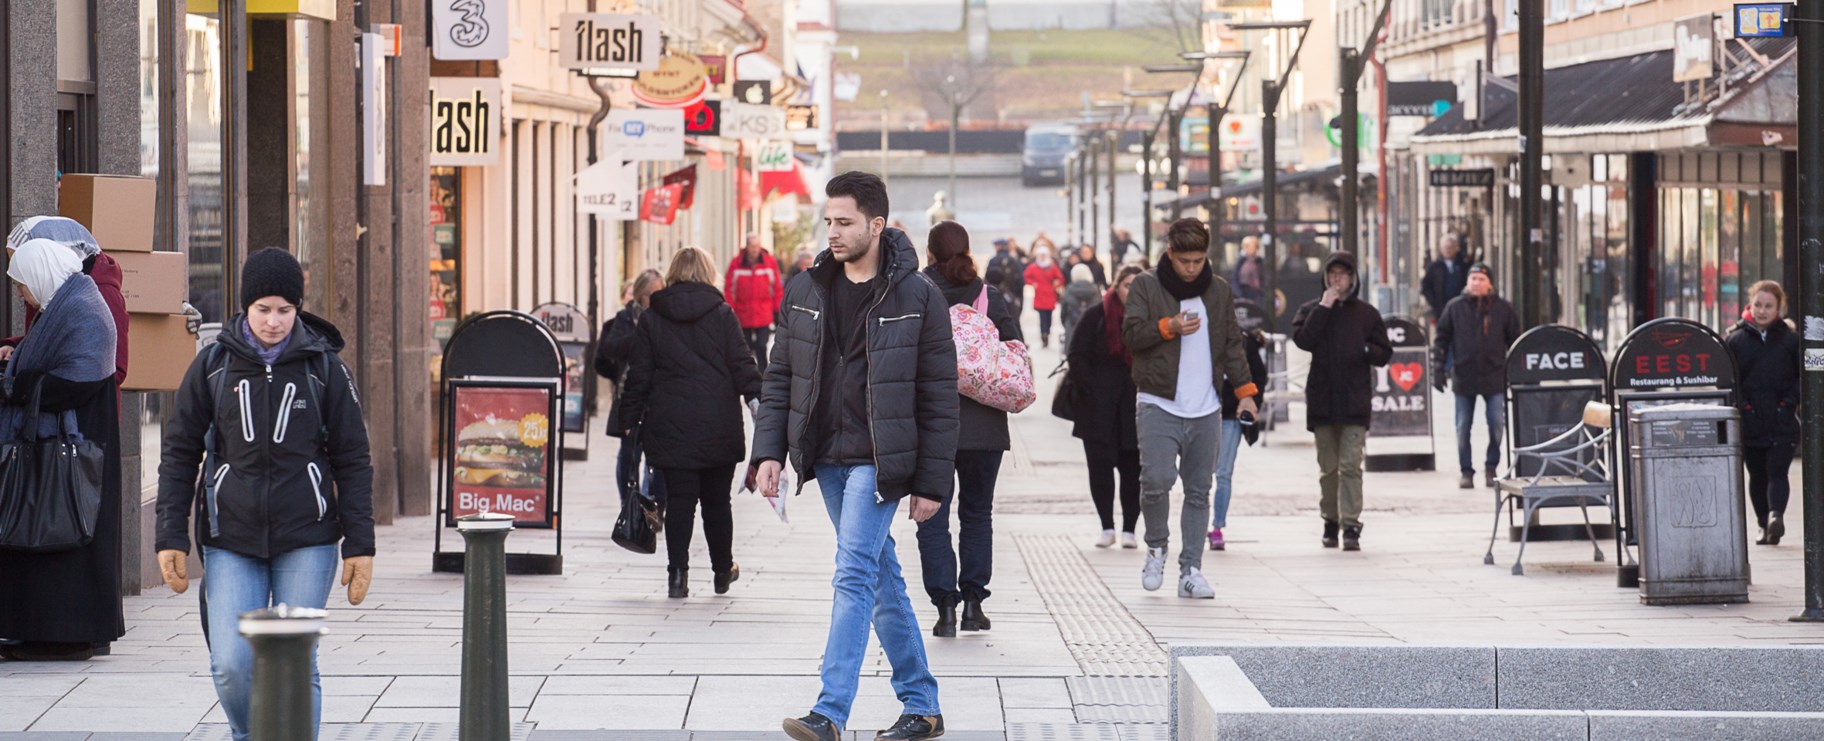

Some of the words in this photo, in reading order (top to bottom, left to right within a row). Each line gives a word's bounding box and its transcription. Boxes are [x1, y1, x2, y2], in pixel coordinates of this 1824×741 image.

[575, 20, 642, 63] flash
[430, 89, 489, 154] lash
[1526, 352, 1584, 370] FACE
[1636, 354, 1711, 374] EEST
[1630, 376, 1675, 387] Restaurang
[1676, 376, 1682, 385] &
[1683, 375, 1718, 385] Sushibar
[1371, 395, 1425, 412] SALE
[459, 492, 490, 513] Big
[496, 493, 535, 512] Mac
